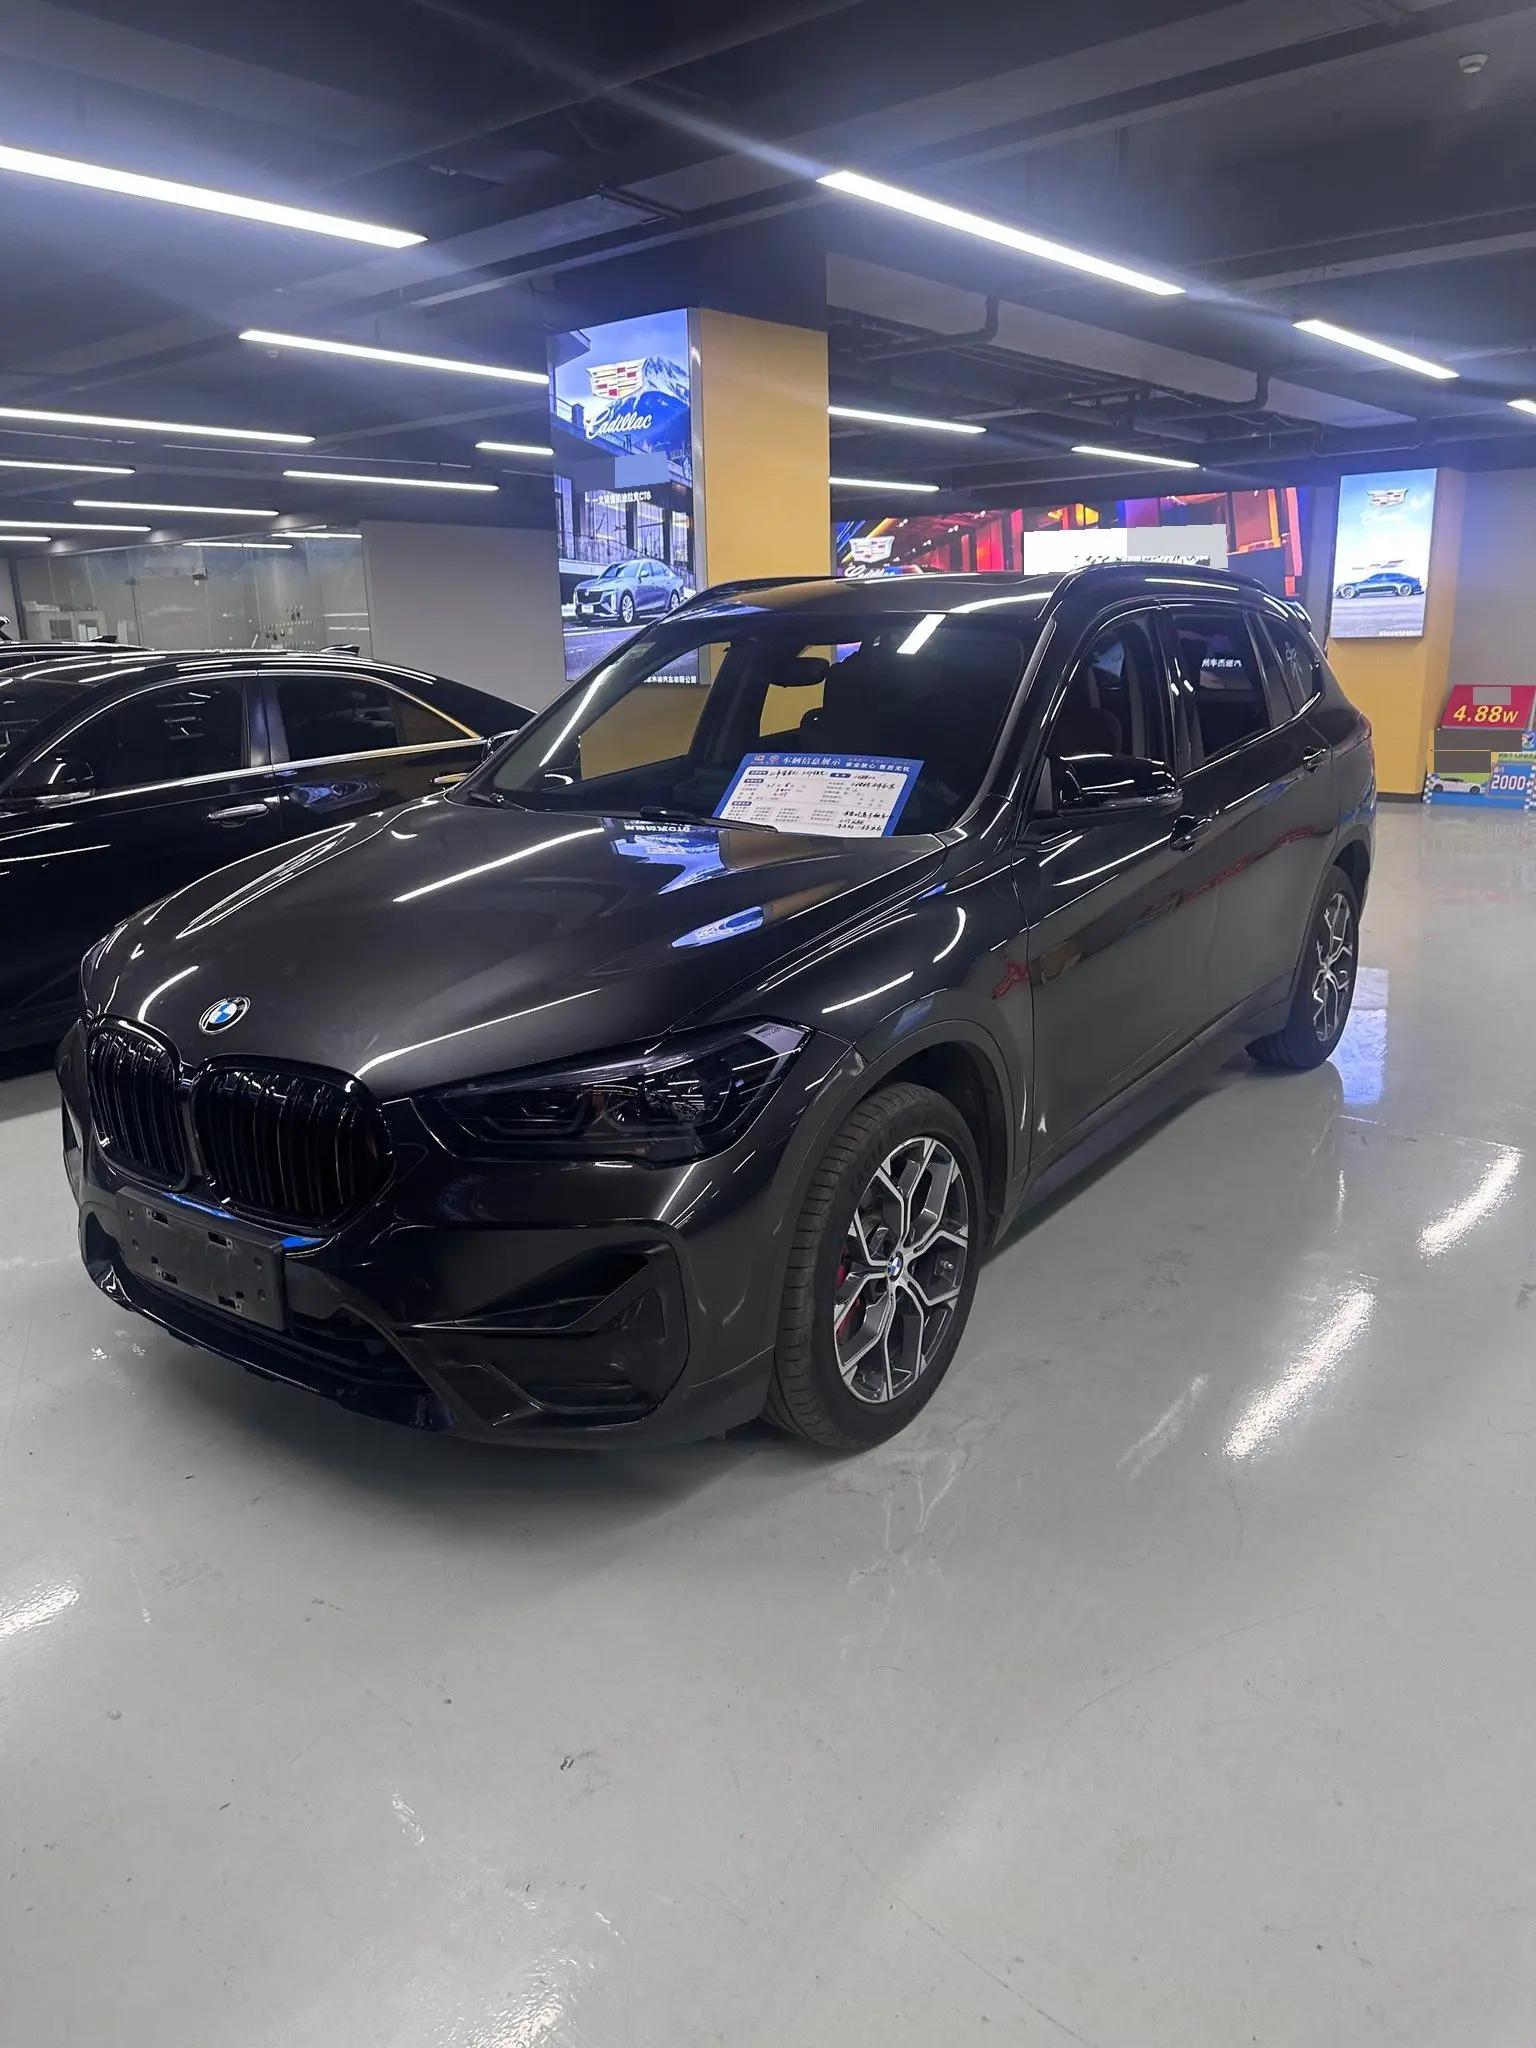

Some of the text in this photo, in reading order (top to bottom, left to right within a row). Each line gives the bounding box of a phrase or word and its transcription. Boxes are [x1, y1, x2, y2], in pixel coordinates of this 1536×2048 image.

[585, 407, 652, 440] Cadillac
[782, 755, 840, 767] 车辆信息展示
